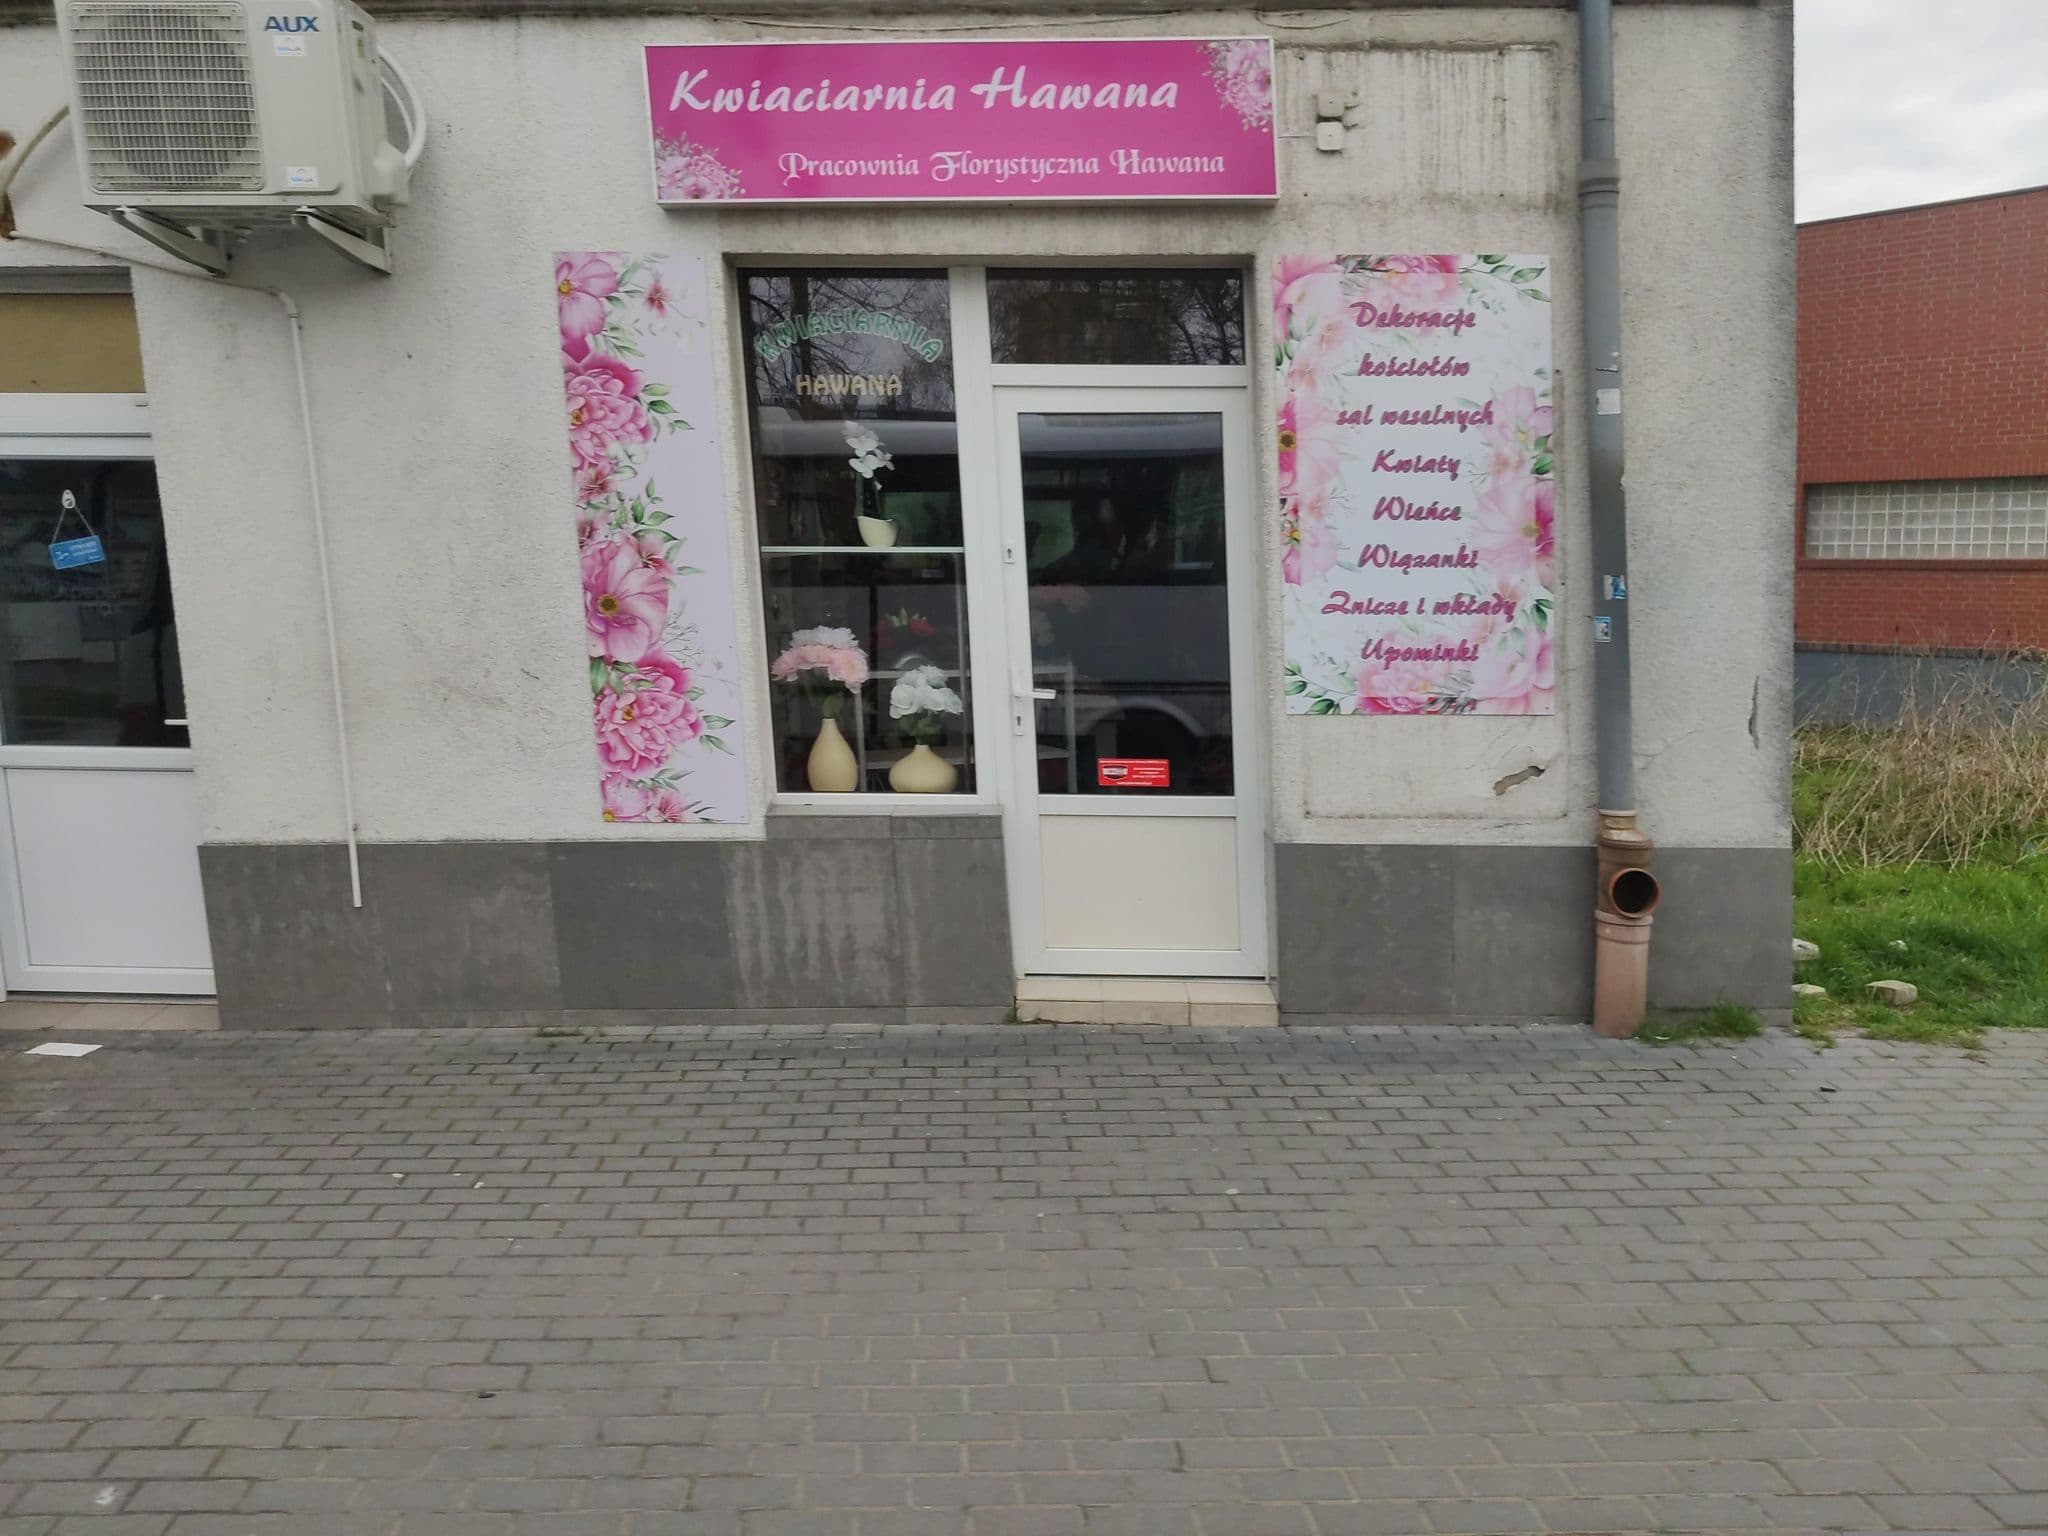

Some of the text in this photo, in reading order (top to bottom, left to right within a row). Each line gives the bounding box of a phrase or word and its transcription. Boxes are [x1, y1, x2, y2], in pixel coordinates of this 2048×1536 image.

[263, 15, 321, 33] AUX
[668, 65, 1179, 113] Kwiaciarnia Hawana
[778, 149, 1225, 187] Pracownia Florystyczna Hawana
[1348, 301, 1477, 336] Dekoracje
[753, 307, 945, 364] KWIACIARNIA
[1358, 352, 1470, 377] kościołów
[795, 373, 903, 397] HAWANA
[1336, 400, 1495, 434] sal weselnych
[1371, 449, 1462, 482] Kwiaty
[1372, 496, 1462, 521] Wieńce
[1357, 543, 1480, 576] Wiązanki
[1321, 590, 1518, 623] Znicze i wkłady
[1361, 638, 1480, 671] Upominki
